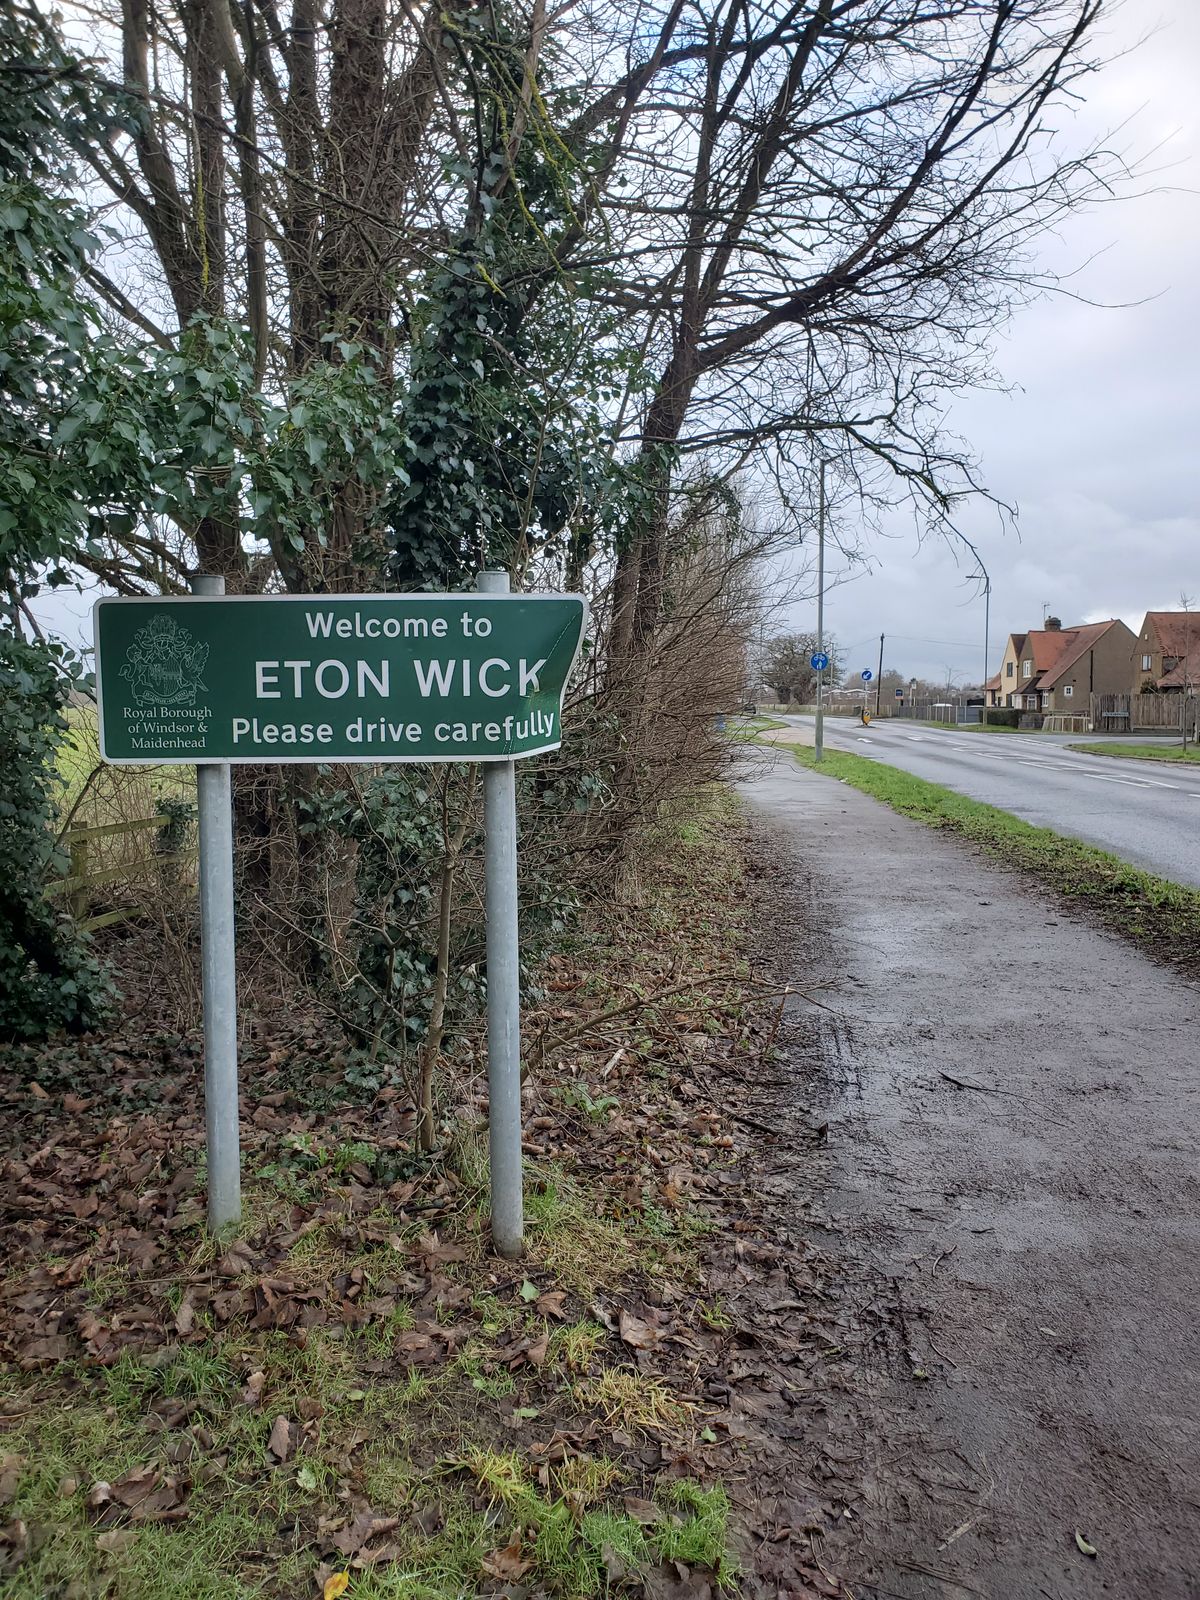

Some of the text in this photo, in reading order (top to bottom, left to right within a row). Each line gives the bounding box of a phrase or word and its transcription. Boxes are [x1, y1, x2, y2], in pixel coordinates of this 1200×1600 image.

[305, 612, 493, 639] Welcome to
[255, 657, 547, 699] ETON WICK
[123, 706, 213, 722] Royal Borough
[128, 722, 208, 733] of Windsor &
[232, 710, 556, 744] Please drive carefully
[131, 737, 206, 749] Maidenhead
